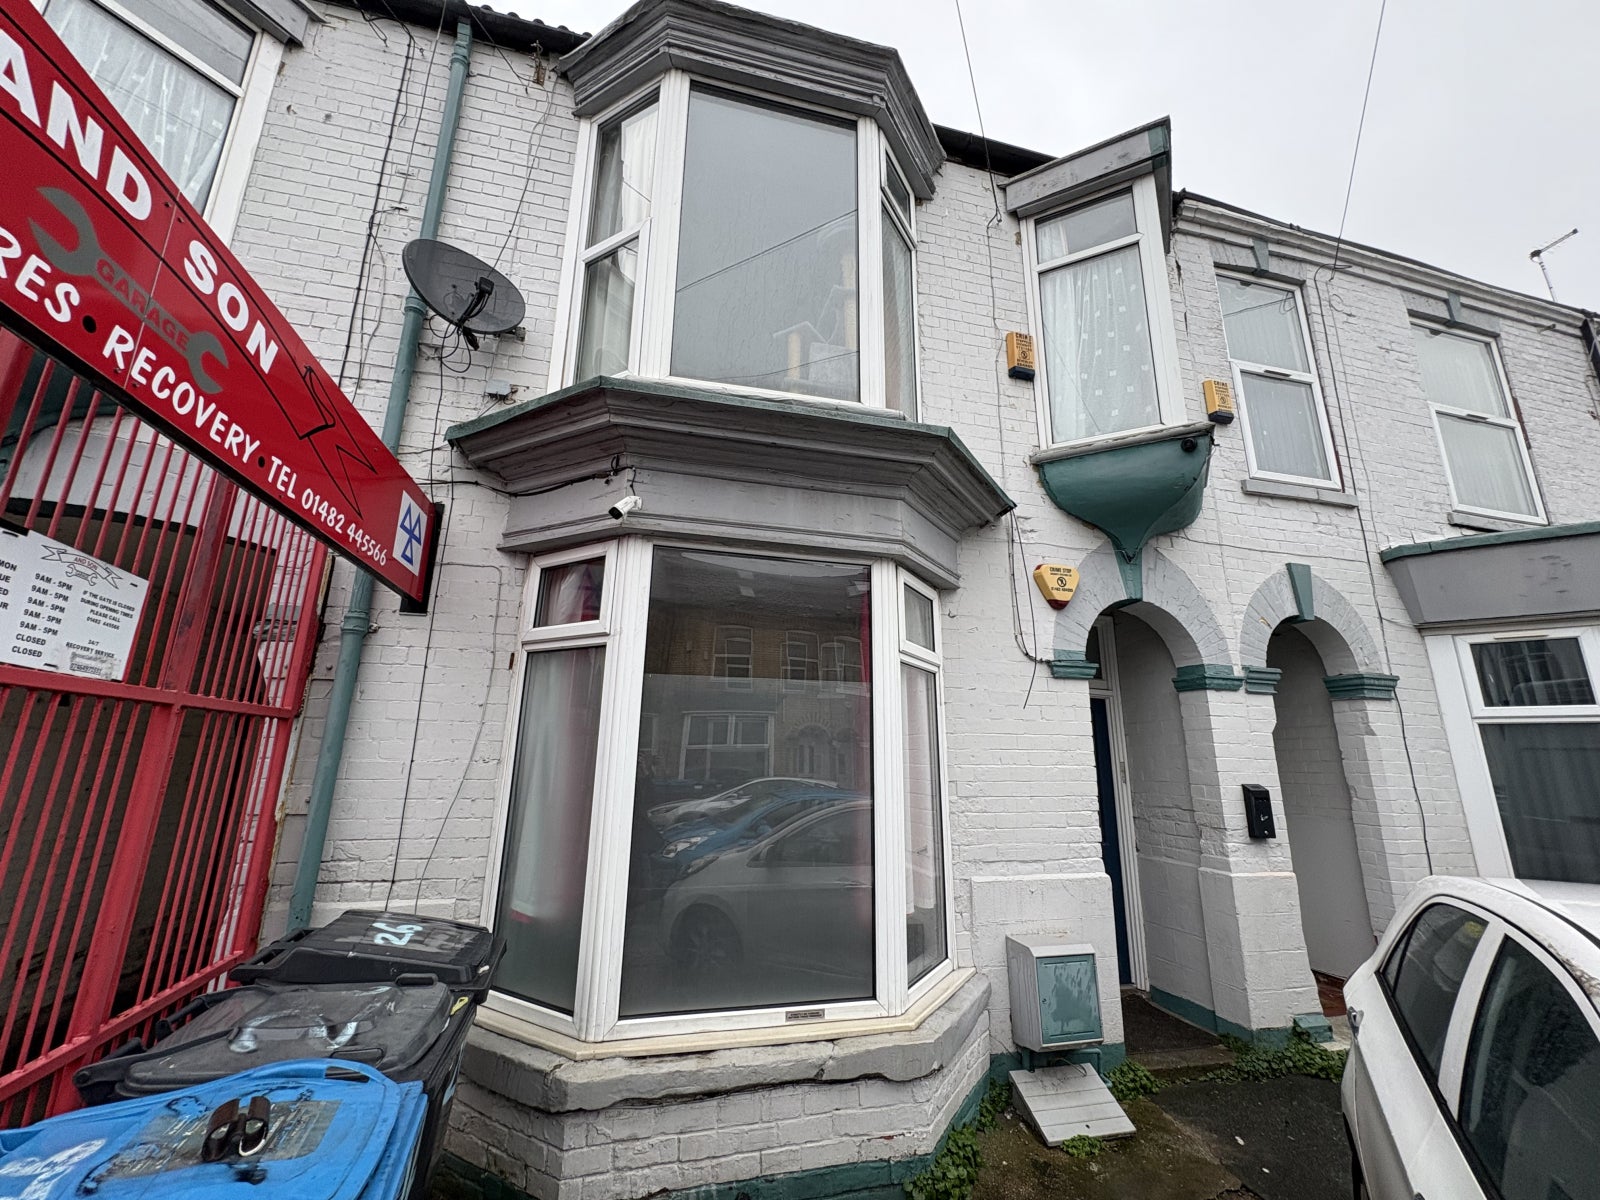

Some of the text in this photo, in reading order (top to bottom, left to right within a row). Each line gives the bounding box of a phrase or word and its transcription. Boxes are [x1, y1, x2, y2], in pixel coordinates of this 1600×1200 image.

[0, 28, 279, 375] AND SON
[96, 258, 190, 350] GARAGE
[102, 324, 261, 464] RECOVERY
[267, 455, 297, 499] TEL
[301, 488, 345, 534] 01482
[347, 523, 388, 566] 445566
[35, 572, 52, 585] 9AM
[57, 580, 73, 591] 5PM
[31, 584, 48, 596] 9AM
[53, 592, 69, 602] 5PM
[89, 591, 99, 599] THE
[99, 595, 113, 605] GATE
[27, 596, 45, 608] 9AM
[50, 603, 66, 613] 5PM
[23, 608, 41, 619] 9AM
[46, 615, 62, 625] 5PM
[19, 620, 37, 631] 9AM
[42, 626, 59, 636] 5PM
[15, 633, 46, 646] CLOSED
[11, 645, 43, 658] CLOSED
[65, 641, 94, 654] RECOVERY
[94, 649, 115, 658] SERVICE
[371, 922, 423, 946] 26
